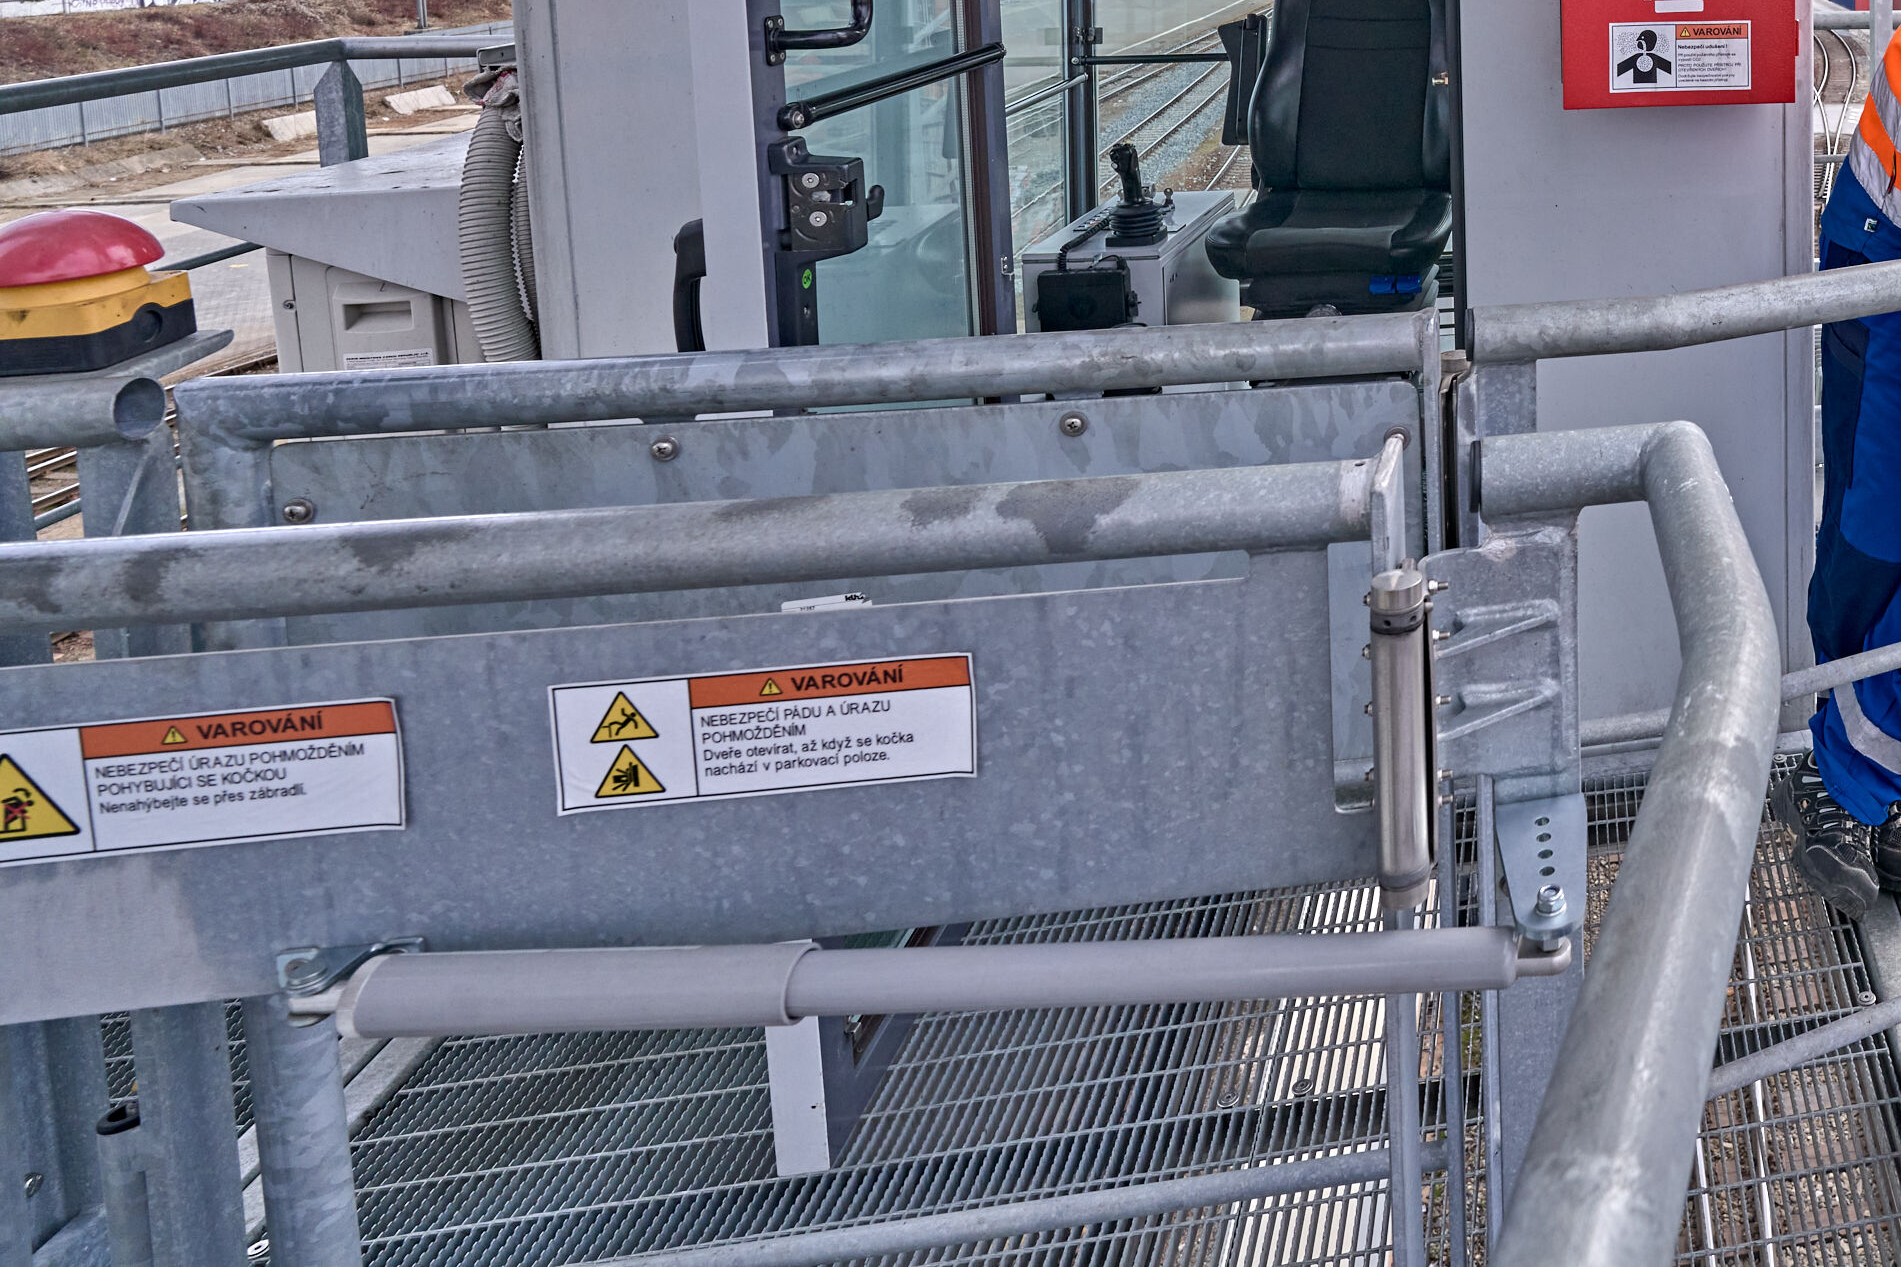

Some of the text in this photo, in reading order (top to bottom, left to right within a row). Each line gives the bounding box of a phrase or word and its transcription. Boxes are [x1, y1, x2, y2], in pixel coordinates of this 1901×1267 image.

[1692, 25, 1742, 36] VAROVÁNÍ
[791, 664, 903, 692] VAROVÁNÍ
[197, 710, 323, 740] VAROVÁNÍ
[700, 698, 892, 728] NEBEZPEČÍ PÁDU A ÚRAZU
[702, 723, 807, 745] POHMOŽDĚNÍM
[703, 731, 914, 762] Dveře otevírat, až když se kočka
[94, 743, 366, 780] NEBEZPEČÍ ÚRAZU POHMOŽDĚNÍM
[704, 750, 890, 778] nachází v parkovací poloze.
[196, 774, 217, 788] SE
[220, 767, 288, 787] KOČKOU
[99, 793, 189, 815] Nenahýbejte
[192, 794, 211, 806] se
[212, 790, 245, 808] přes
